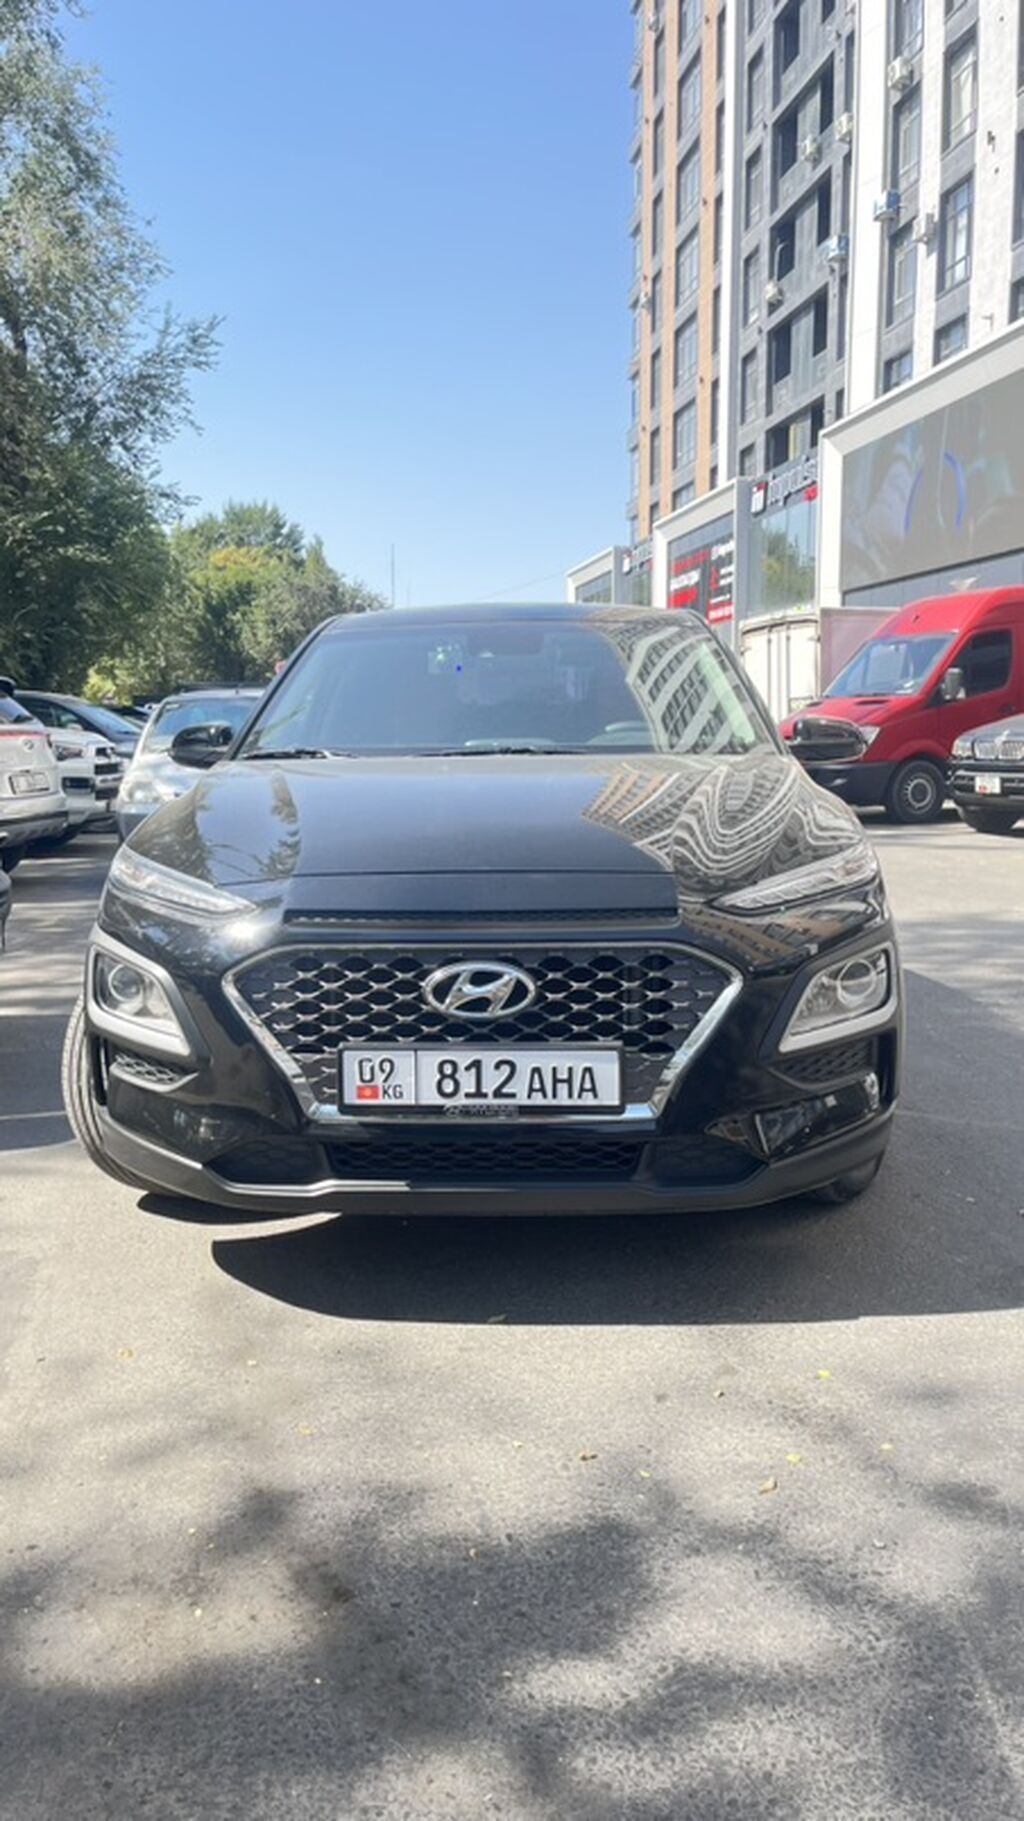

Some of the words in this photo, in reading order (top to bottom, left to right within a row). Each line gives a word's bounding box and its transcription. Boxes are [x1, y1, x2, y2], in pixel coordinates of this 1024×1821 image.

[358, 1057, 395, 1083] 09
[436, 1058, 517, 1098] 812
[527, 1066, 598, 1099] AHA
[382, 1084, 404, 1099] KG
